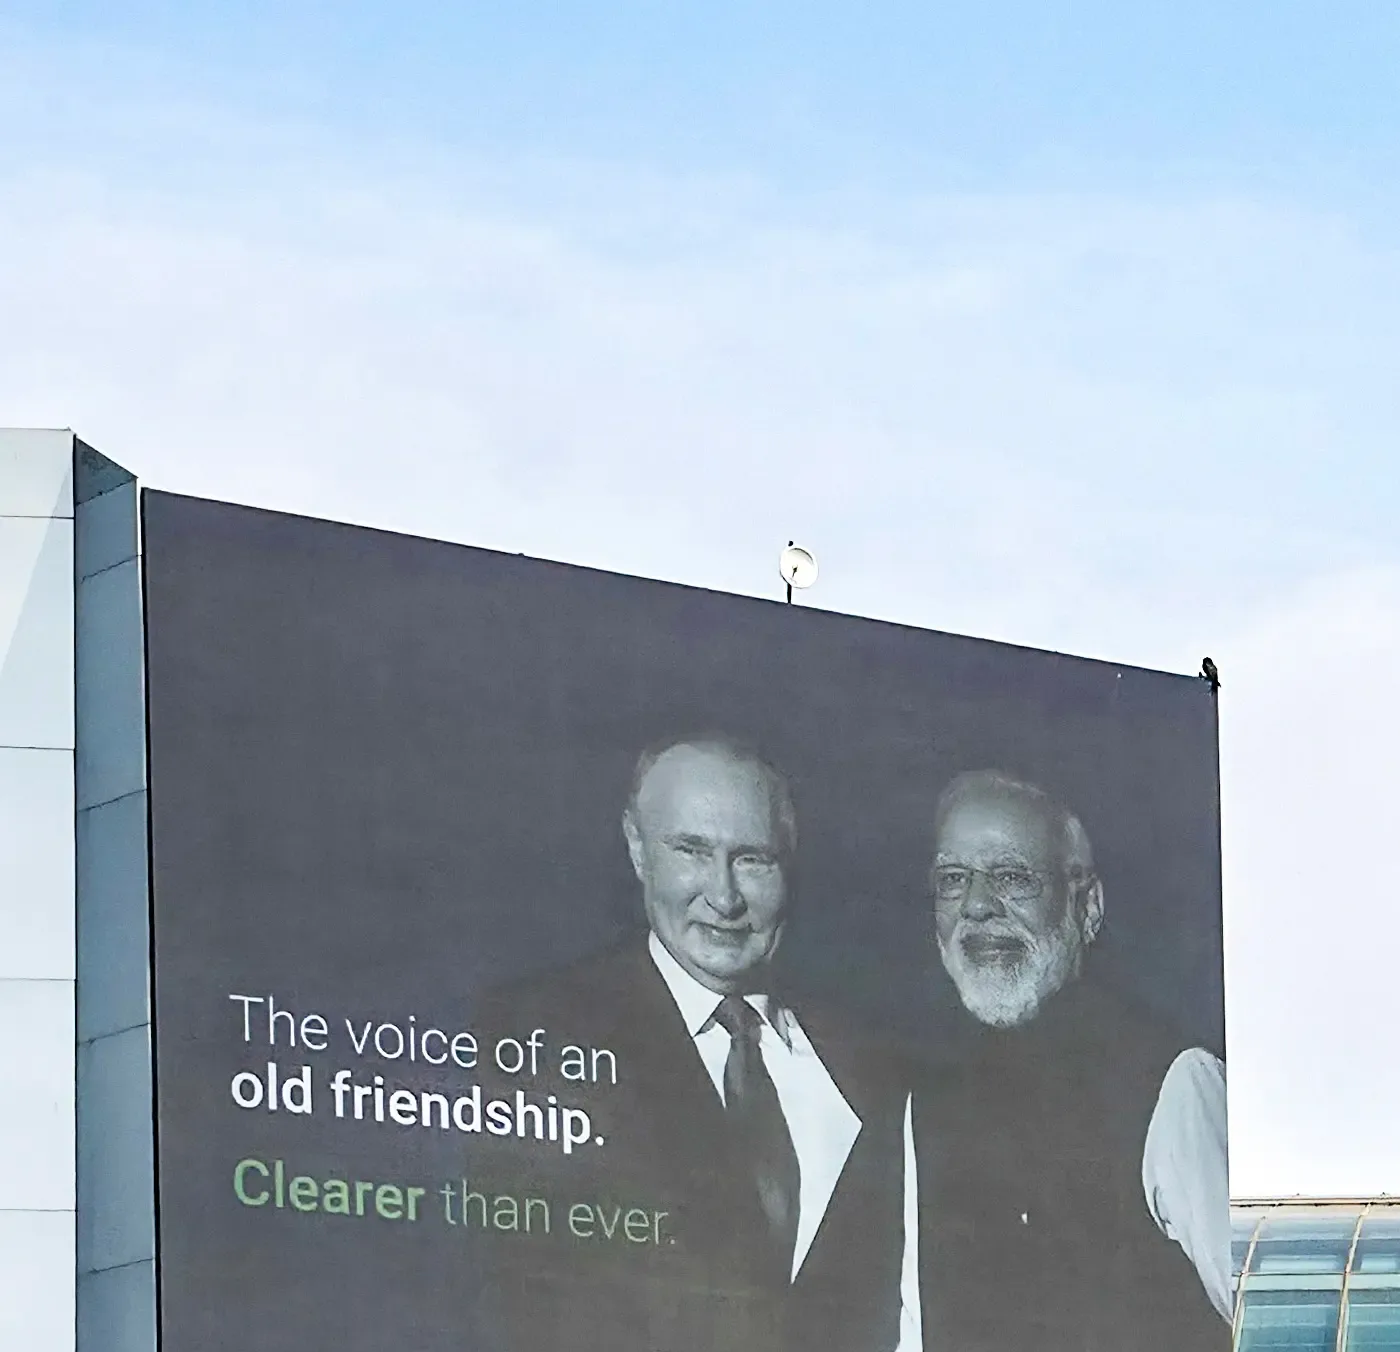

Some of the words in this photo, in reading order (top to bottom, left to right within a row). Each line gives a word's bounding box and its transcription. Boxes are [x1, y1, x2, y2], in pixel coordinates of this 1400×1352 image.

[229, 994, 328, 1050] The
[345, 1016, 479, 1067] voice
[496, 1029, 546, 1075] of
[560, 1044, 618, 1084] an
[231, 1062, 312, 1115] old
[331, 1070, 605, 1153] friendship.
[233, 1159, 425, 1221] Clearer
[439, 1178, 550, 1234] than
[568, 1201, 676, 1245] ever.
